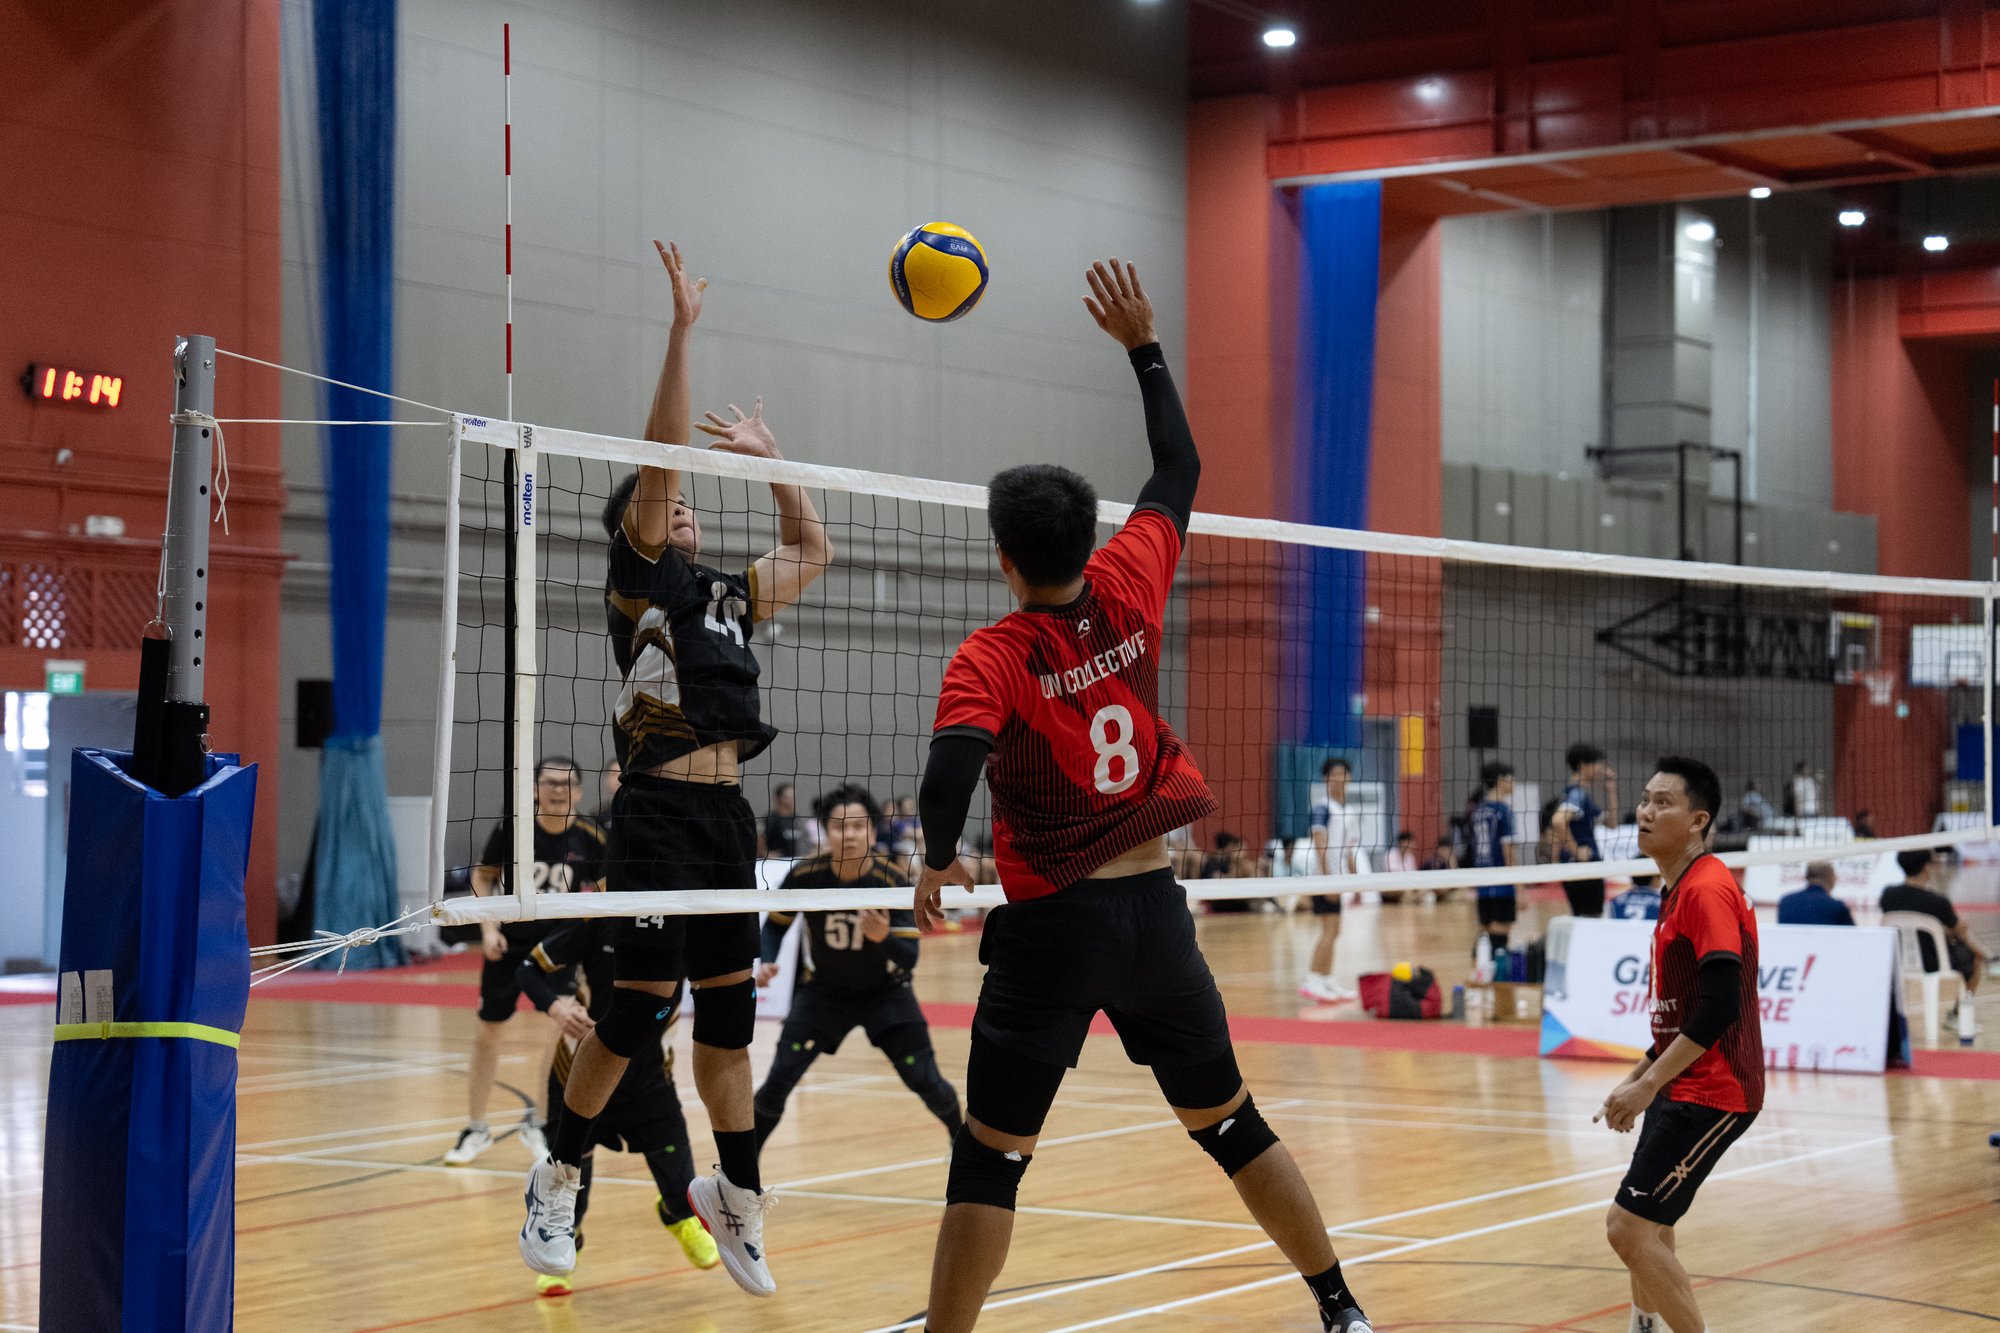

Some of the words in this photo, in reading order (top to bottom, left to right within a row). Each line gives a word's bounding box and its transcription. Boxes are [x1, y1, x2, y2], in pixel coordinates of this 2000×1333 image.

[43, 367, 122, 407] 11:14
[522, 473, 533, 526] molten
[1039, 672, 1063, 699] UN
[1090, 704, 1140, 794] 8
